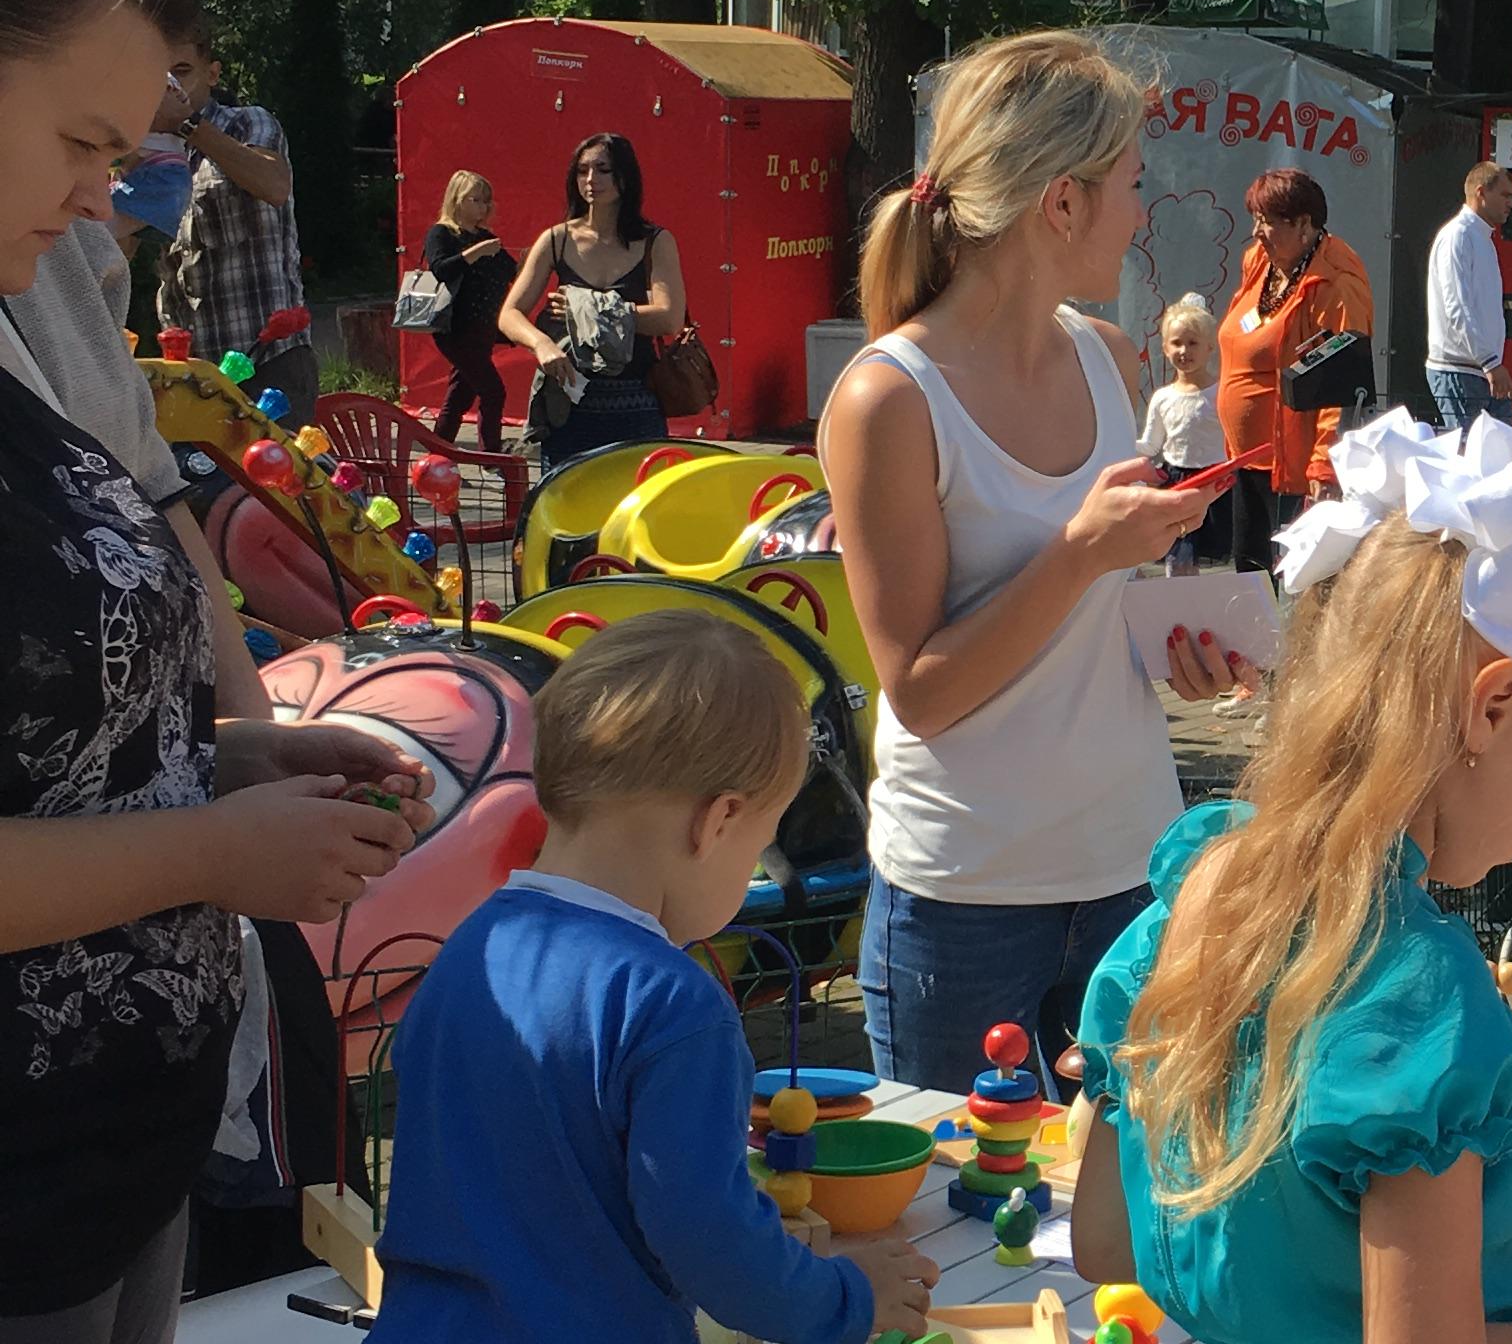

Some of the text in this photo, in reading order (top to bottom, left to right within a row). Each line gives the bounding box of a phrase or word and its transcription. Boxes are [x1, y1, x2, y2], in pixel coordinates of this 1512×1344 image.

[537, 55, 583, 69] Попкорн
[1226, 91, 1360, 157] ВАТА
[766, 236, 834, 260] Попкорн
